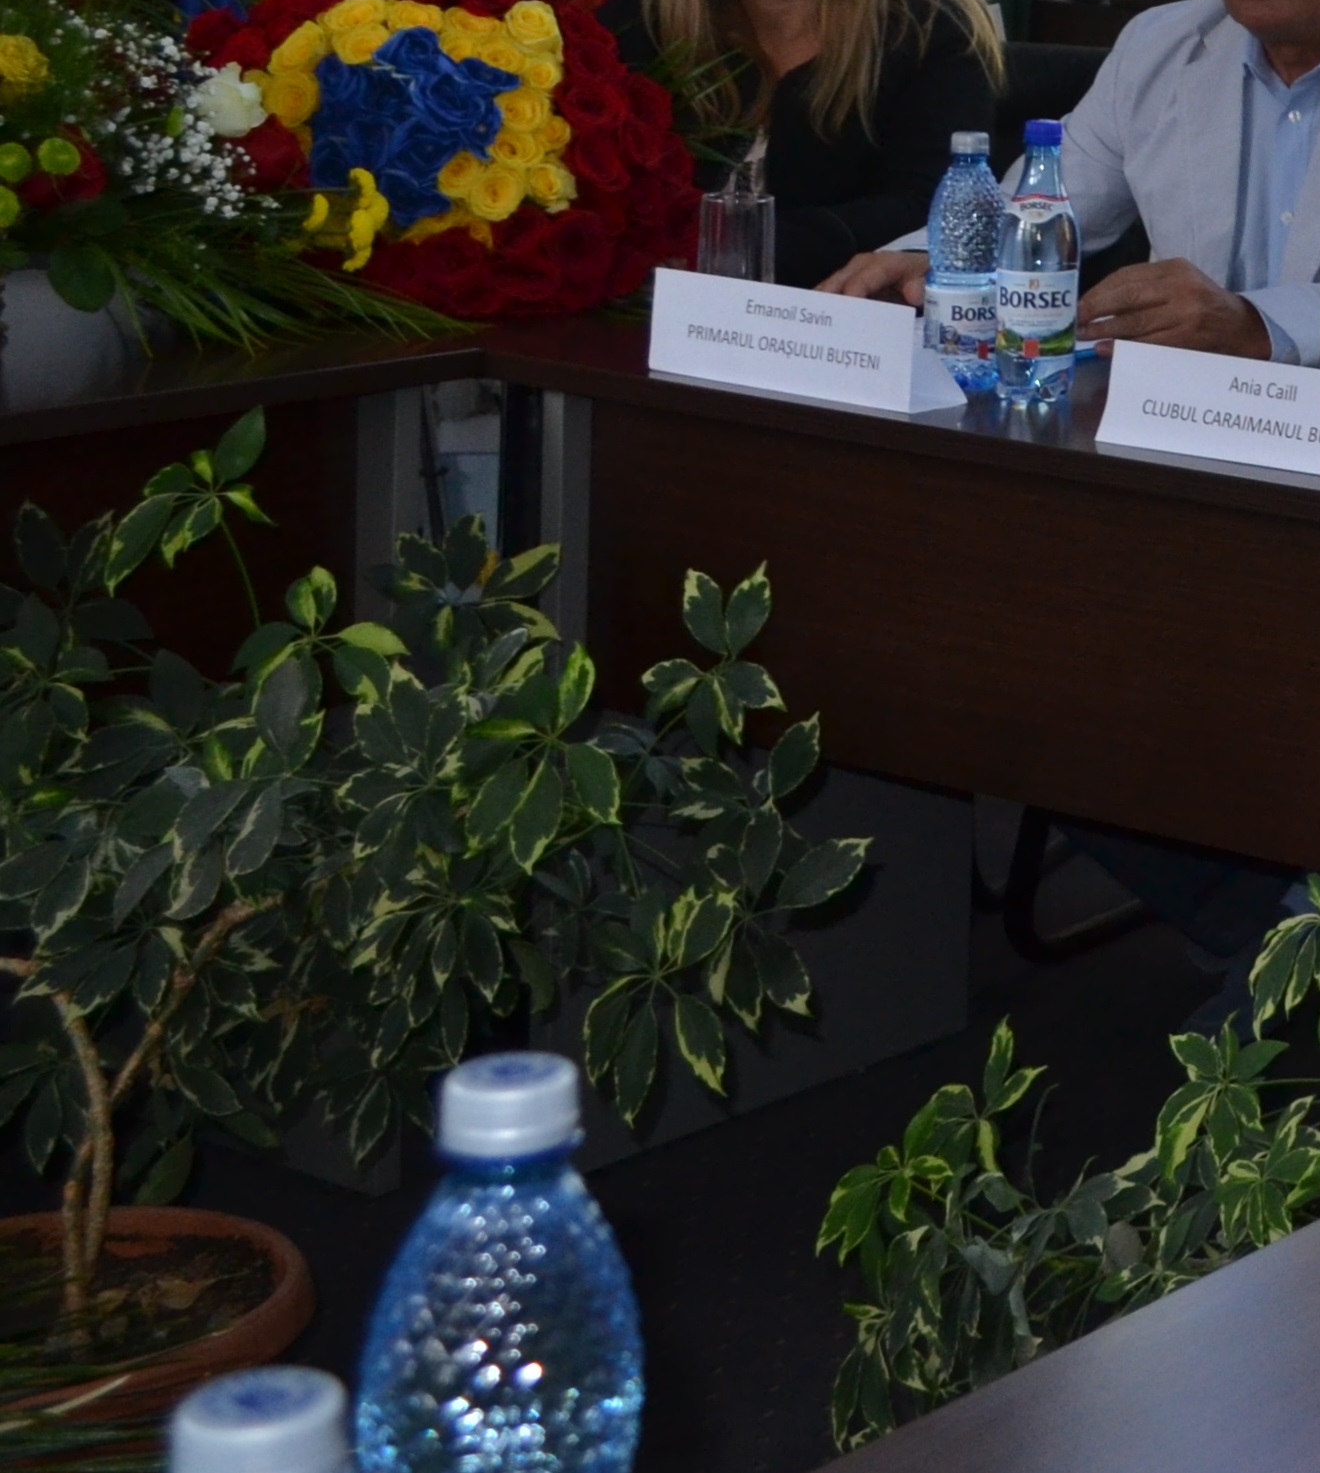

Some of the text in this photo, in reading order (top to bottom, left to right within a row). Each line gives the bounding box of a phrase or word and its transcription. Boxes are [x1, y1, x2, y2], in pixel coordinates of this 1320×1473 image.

[999, 285, 1072, 309] BORSEC
[745, 299, 833, 328] Emanoil Savin
[950, 304, 997, 321] BORS
[687, 323, 881, 371] PRIMARUL ORAȘULUI BUȘTENI
[1228, 376, 1298, 402] Ania Caill
[1142, 399, 1199, 423] CLUBUL
[1202, 408, 1303, 441] CARAIMANUL
